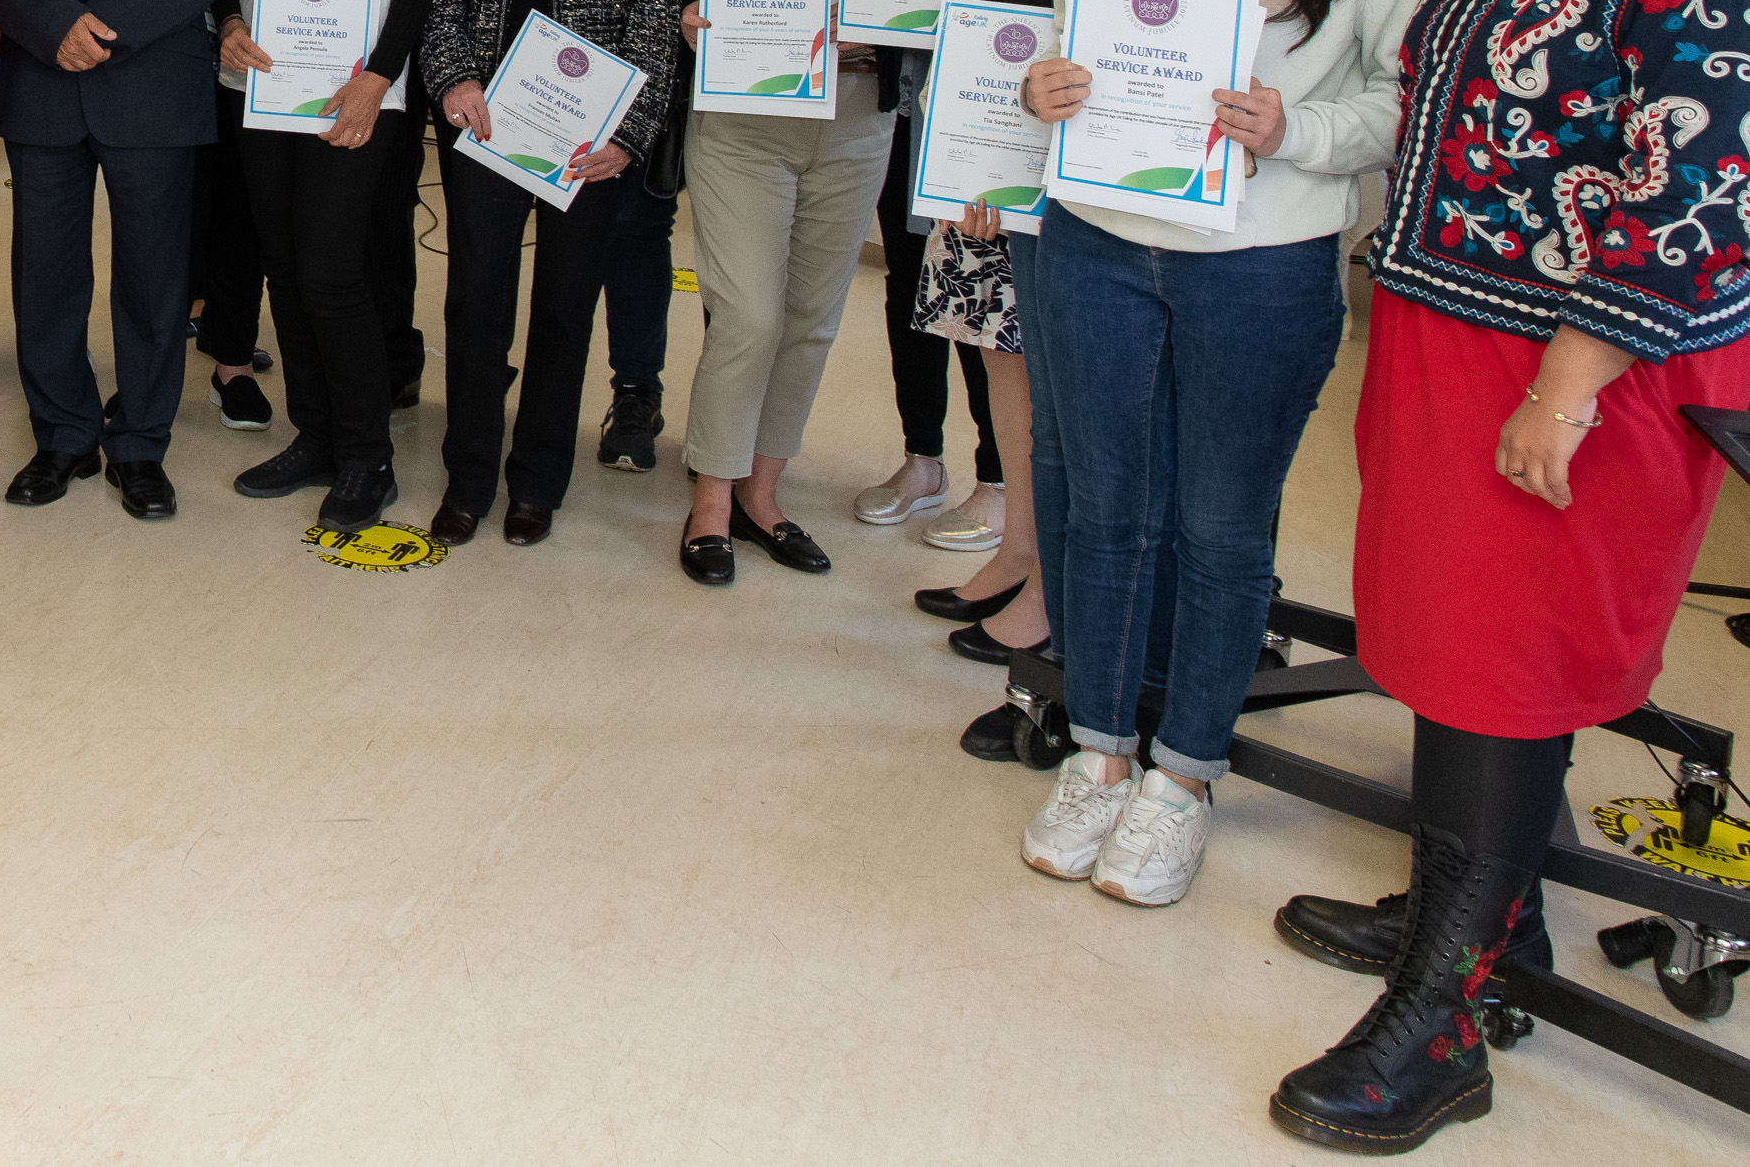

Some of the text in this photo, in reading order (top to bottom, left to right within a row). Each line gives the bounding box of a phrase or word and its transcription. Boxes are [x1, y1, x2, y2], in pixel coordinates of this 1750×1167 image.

[727, 0, 806, 9] SERVICE AWARD
[288, 15, 338, 26] VOLUNTEER
[994, 18, 1008, 28] THE
[276, 27, 348, 38] SERVICE AWARD
[1148, 20, 1180, 35] JUBILEE
[1114, 43, 1188, 62] VOLUNTEER
[1096, 59, 1202, 81] SERVICE AWARD
[535, 74, 581, 105] VOLUNTEER
[976, 77, 1019, 91] VOLUNT
[1128, 80, 1155, 88] awarded
[519, 79, 586, 120] SERVICE AWARD
[958, 91, 1007, 105] SERVICE
[1108, 95, 1143, 104] recognition
[969, 124, 1000, 132] recognition
[994, 119, 1022, 128] Sanghani
[320, 556, 351, 568] AIT
[1598, 807, 1625, 836] PLEAS
